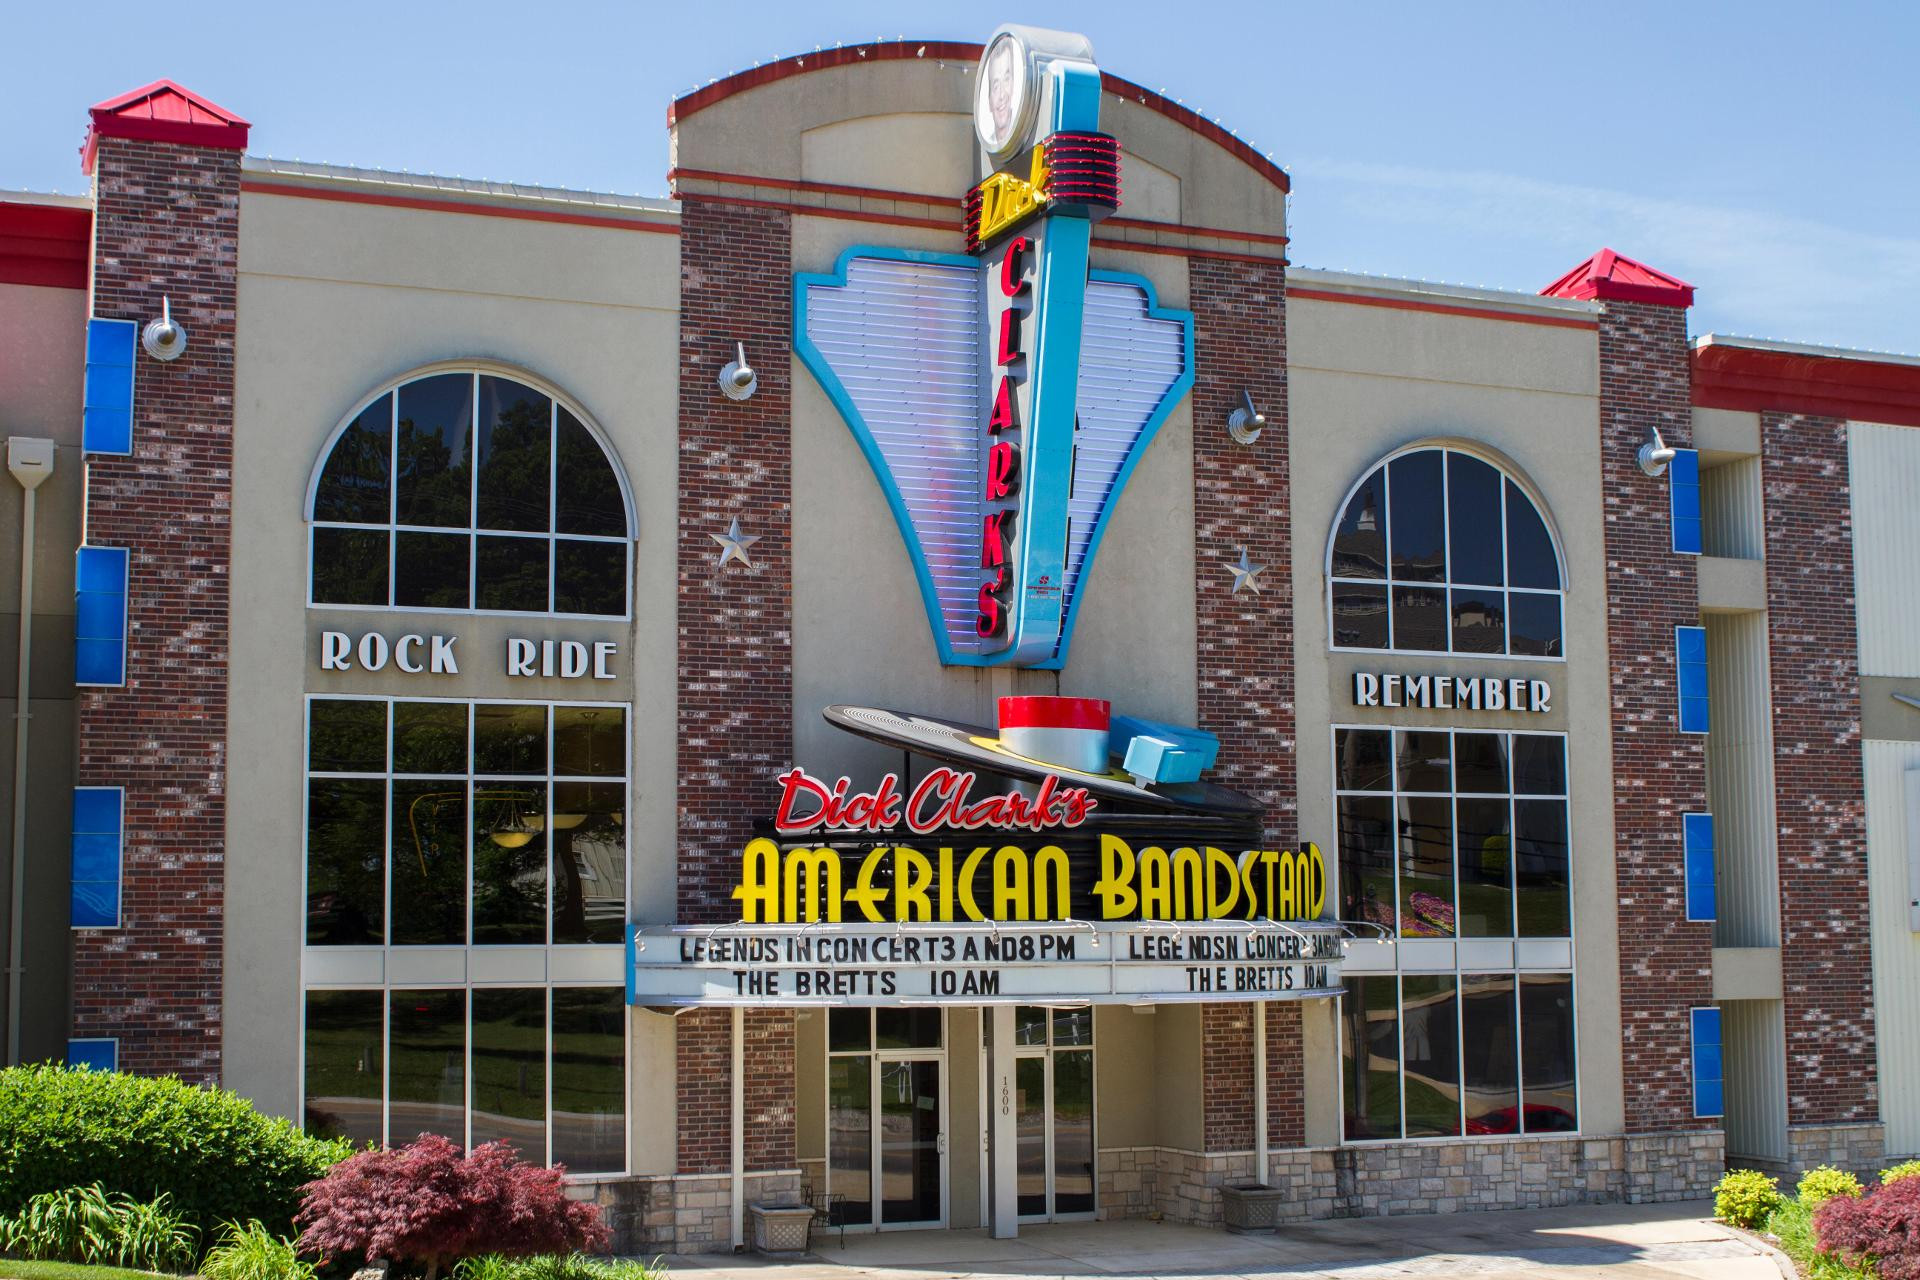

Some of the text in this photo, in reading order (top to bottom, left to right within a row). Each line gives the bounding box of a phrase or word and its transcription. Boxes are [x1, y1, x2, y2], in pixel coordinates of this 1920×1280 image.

[979, 144, 1051, 240] Dick
[321, 631, 617, 679] ROCK RIDE
[1353, 672, 1552, 713] REMEMBER
[773, 766, 1098, 834] Dick Clark's
[731, 833, 1326, 923] AMERICAN BANDSTAND
[680, 936, 778, 962] LEGENDS
[733, 970, 779, 996] THE
[796, 969, 897, 996] BRETTS
[1186, 966, 1228, 992] THE
[1235, 965, 1293, 991] BRETTS
